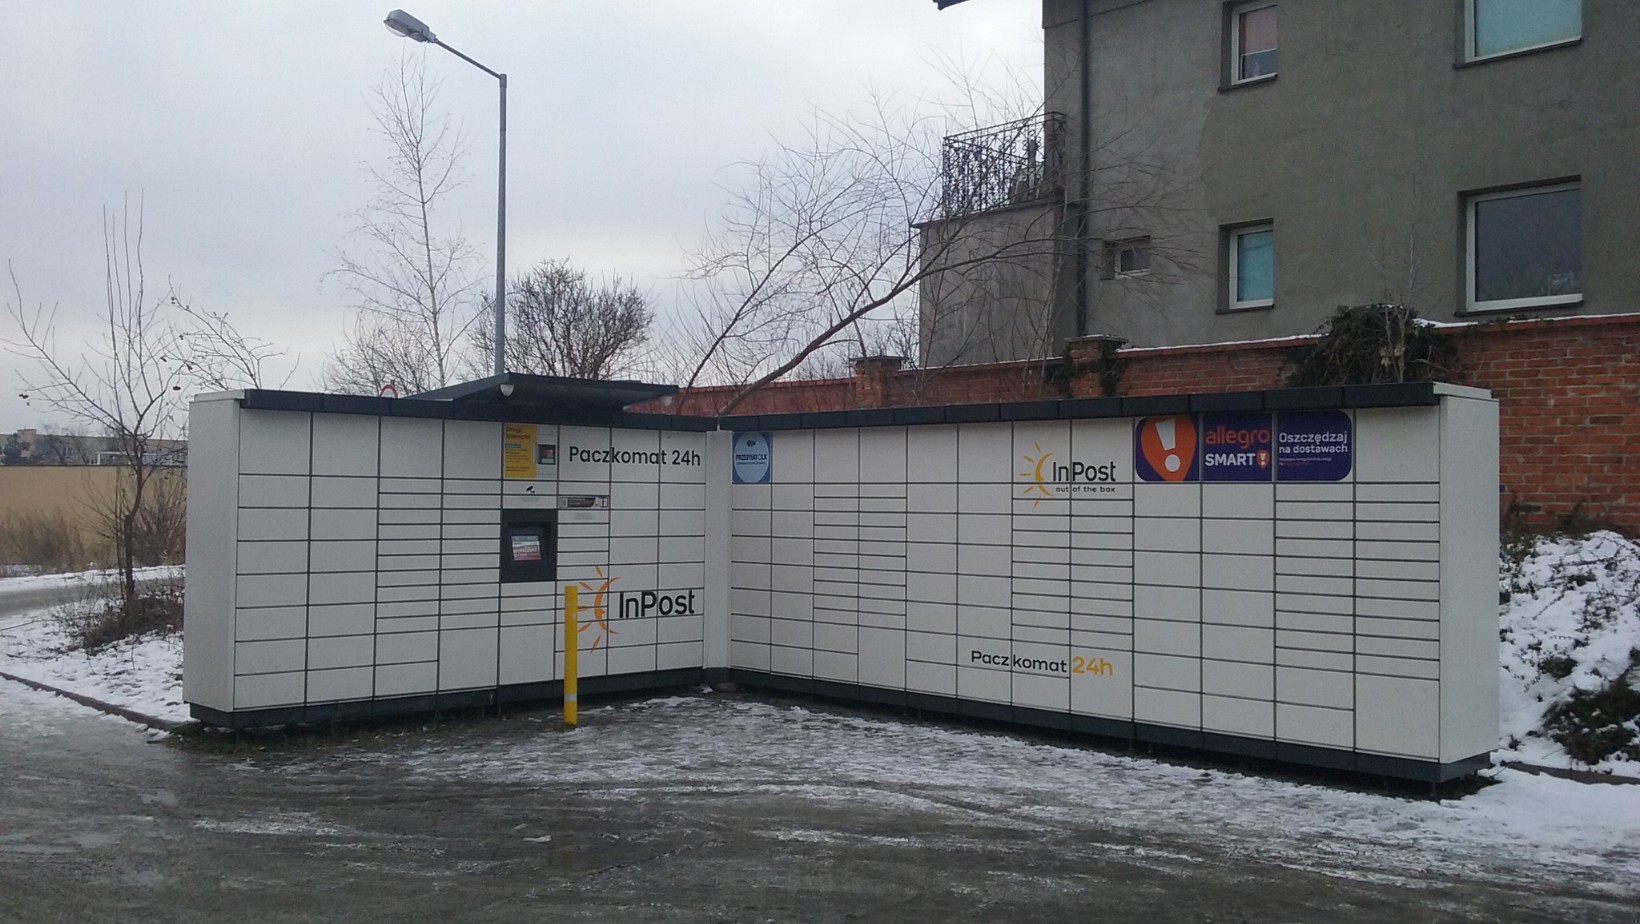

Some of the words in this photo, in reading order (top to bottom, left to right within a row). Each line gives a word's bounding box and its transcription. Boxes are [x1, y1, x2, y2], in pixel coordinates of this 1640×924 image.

[1205, 425, 1271, 449] allegro
[1279, 430, 1348, 445] Oszczędzaj
[569, 446, 667, 465] Paczkomat
[672, 450, 701, 466] 24h
[1293, 444, 1348, 453] dostawach
[1053, 461, 1116, 482] InPost
[619, 590, 695, 618] InPost
[971, 650, 1067, 673] Paczkomat
[1072, 656, 1113, 676] 24h
